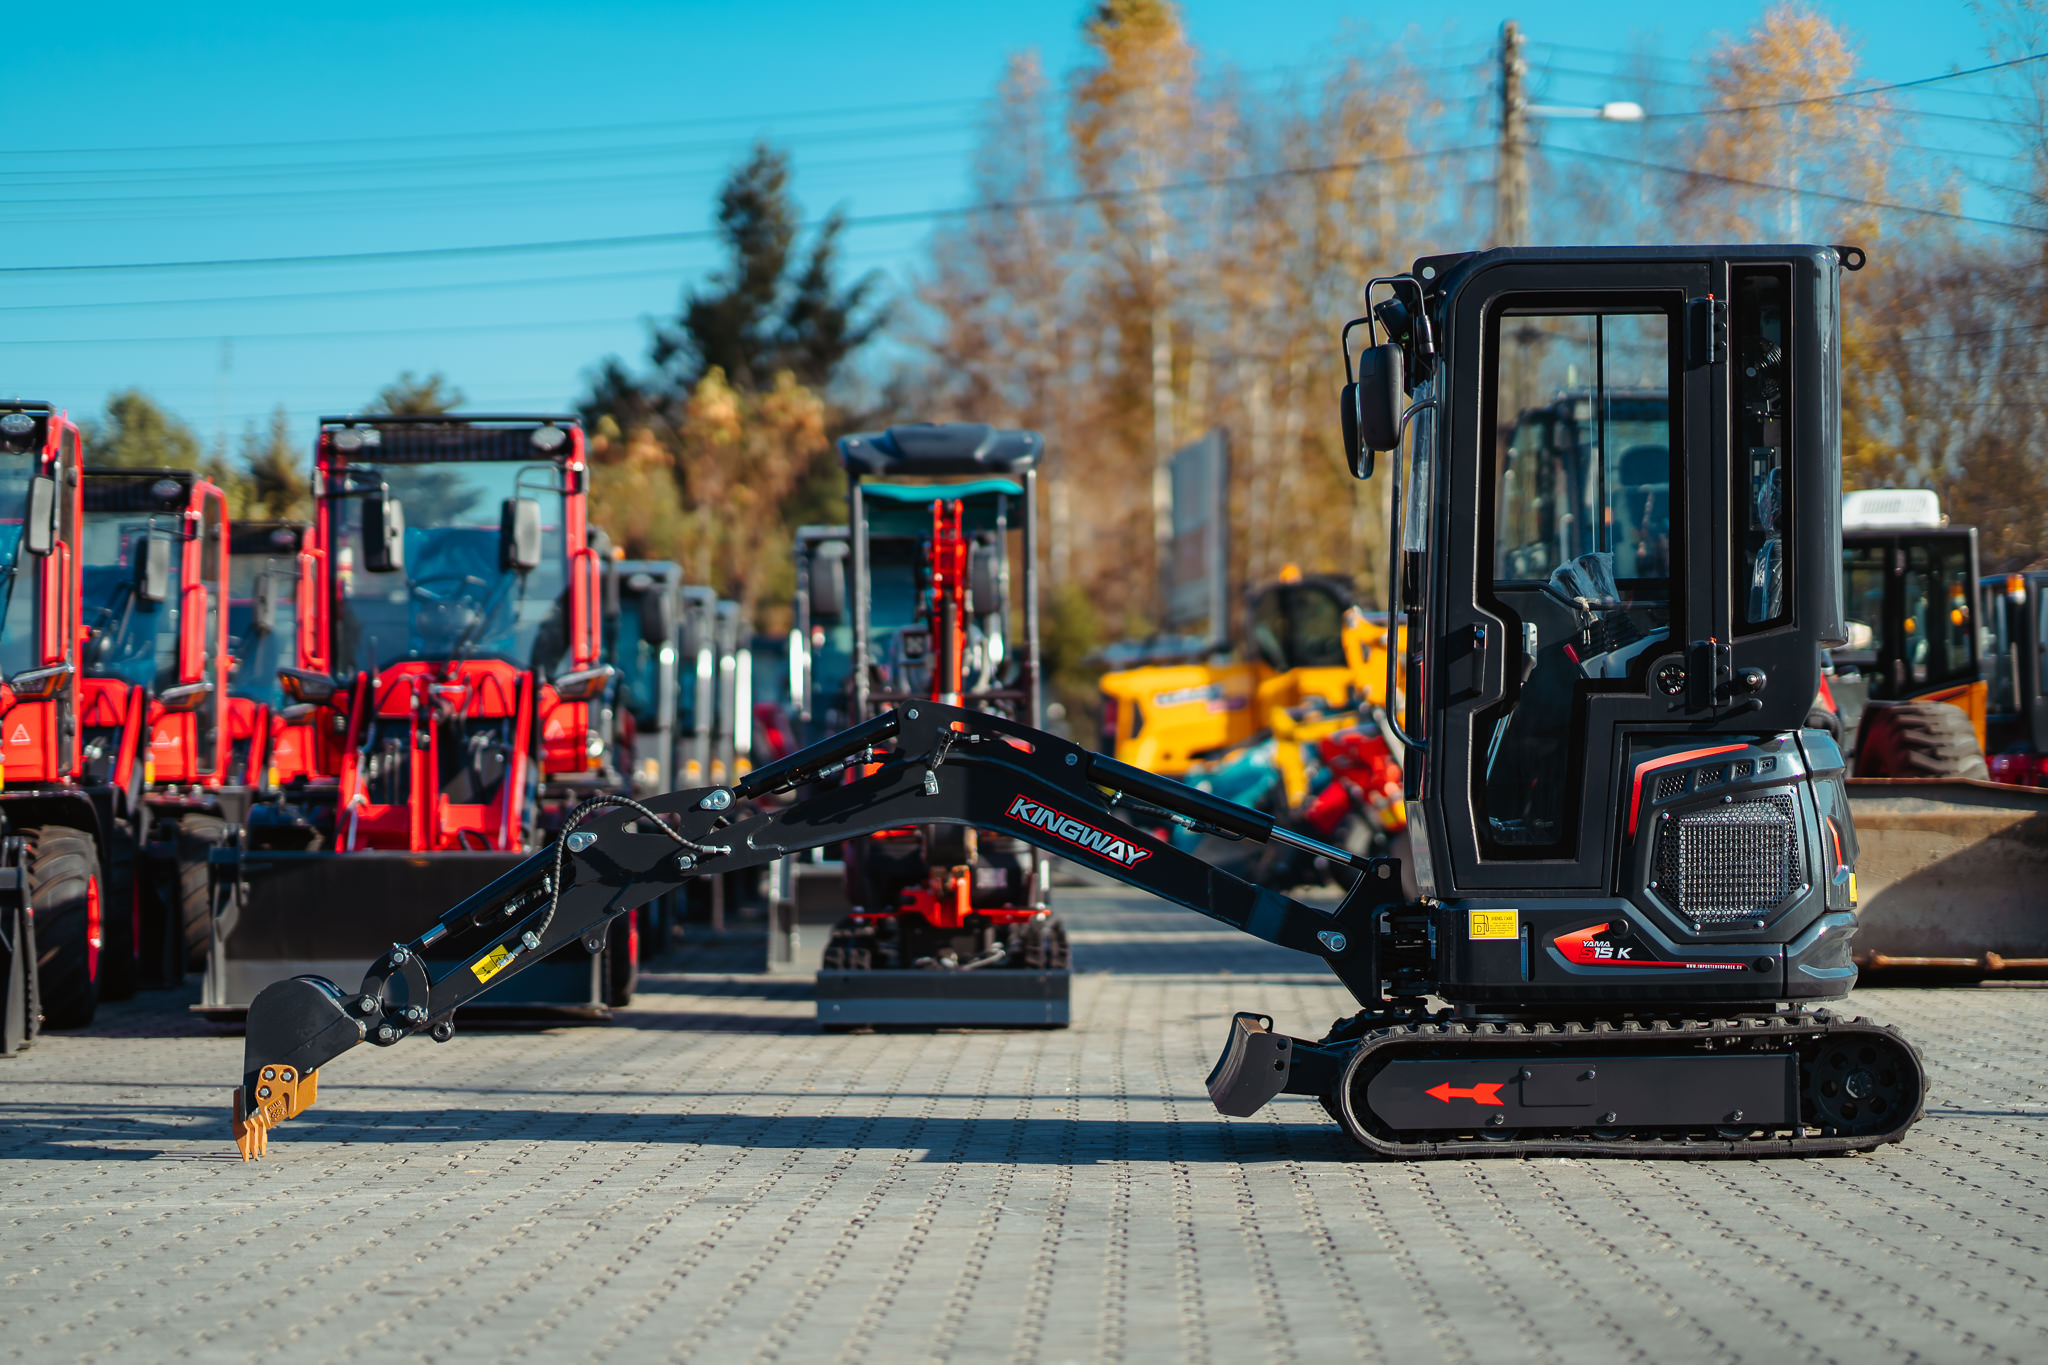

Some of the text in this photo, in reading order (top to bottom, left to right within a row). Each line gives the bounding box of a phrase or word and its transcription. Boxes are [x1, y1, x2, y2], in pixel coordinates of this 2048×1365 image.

[1008, 797, 1150, 867] KINGWAY
[1582, 940, 1611, 948] YAMA
[1617, 947, 1633, 959] K
